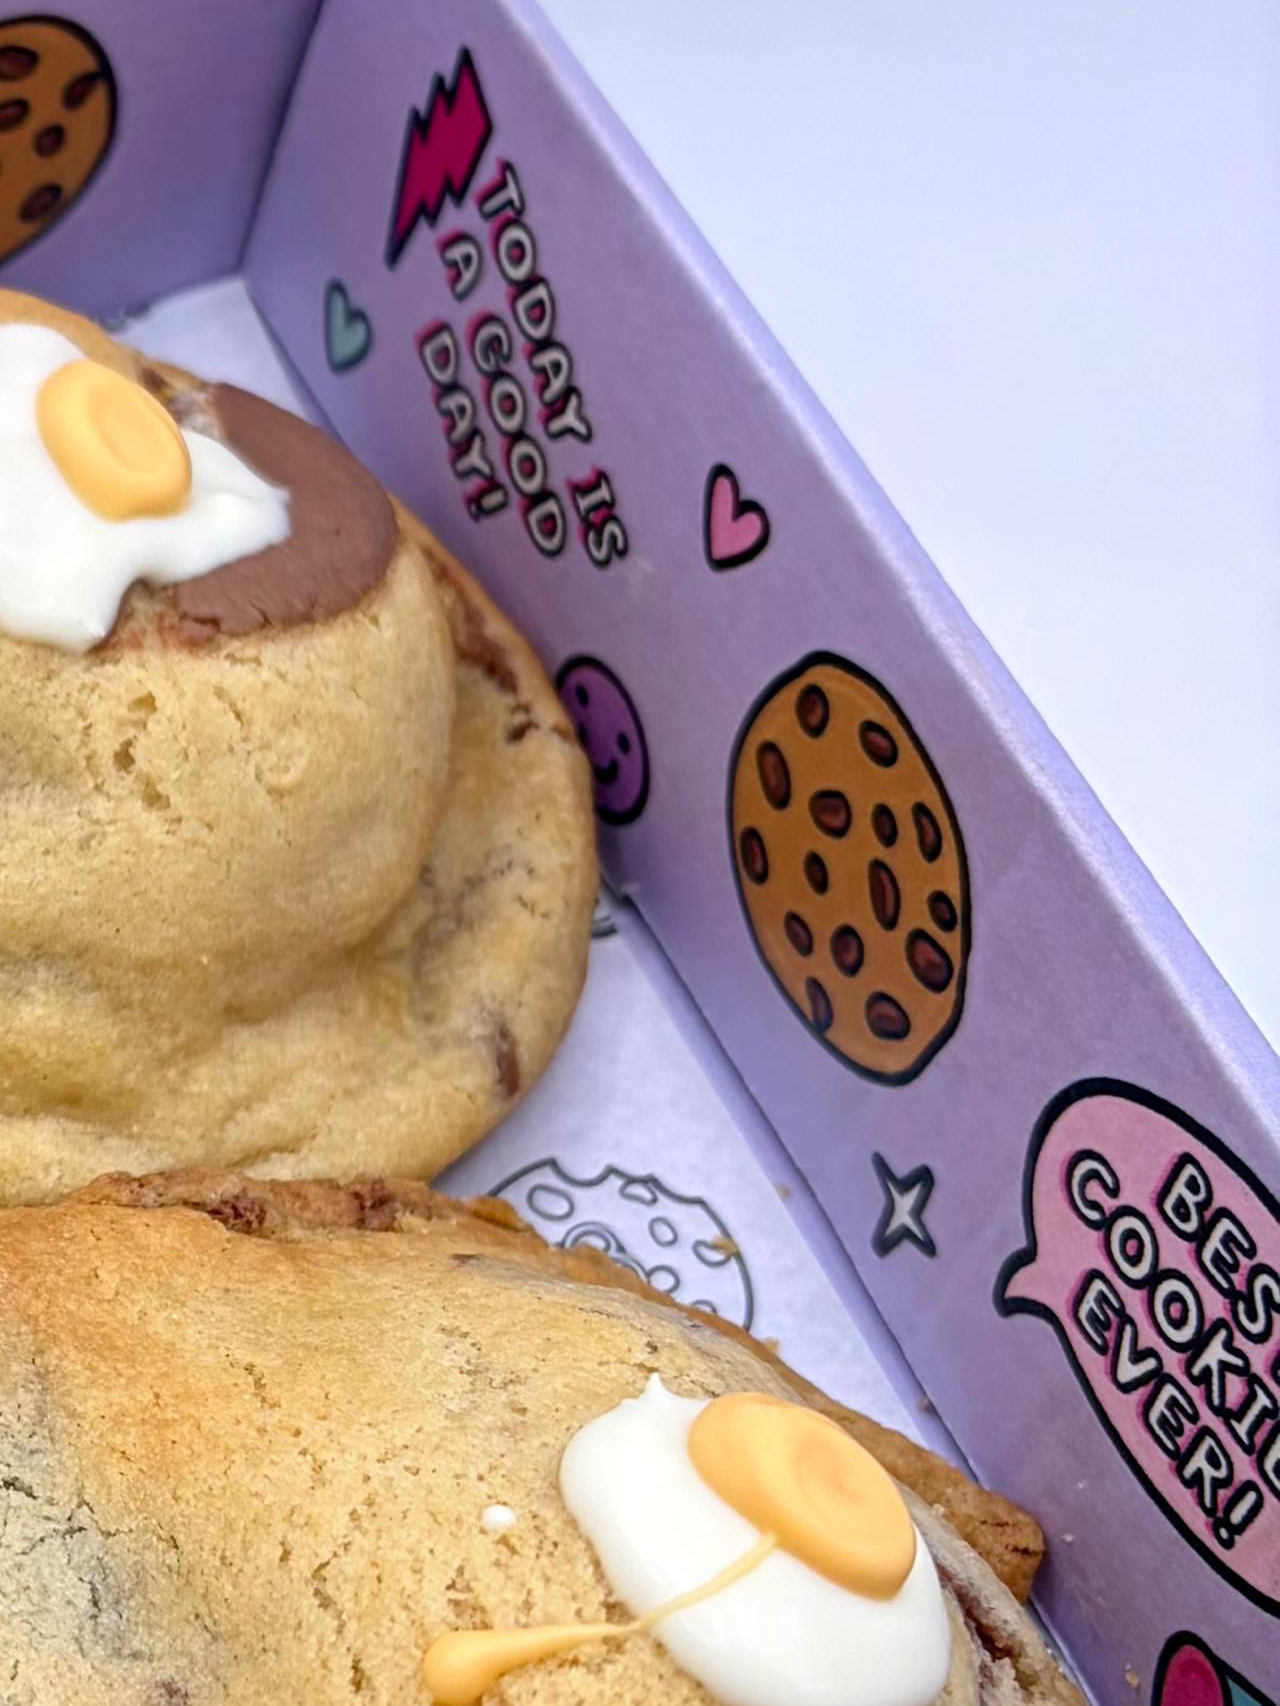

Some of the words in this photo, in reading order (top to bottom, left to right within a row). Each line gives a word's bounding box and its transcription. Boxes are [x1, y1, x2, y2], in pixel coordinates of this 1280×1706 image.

[416, 320, 510, 522] DAY!
[440, 231, 484, 302] A
[467, 311, 568, 559] GOOD
[476, 159, 592, 444] TODAY
[568, 466, 628, 569] IS
[1153, 1152, 1280, 1383] BES
[1072, 1269, 1264, 1550] EVER!
